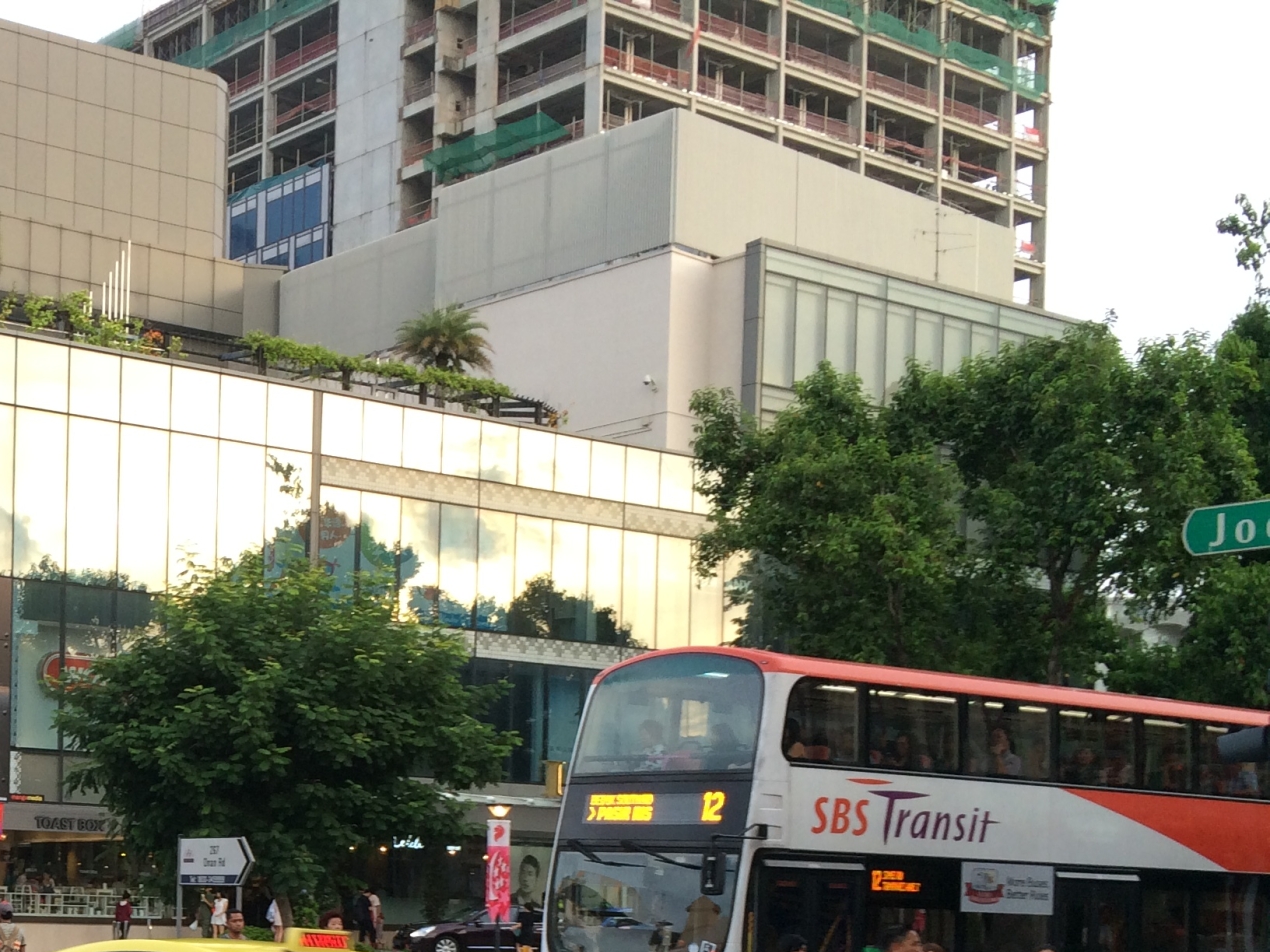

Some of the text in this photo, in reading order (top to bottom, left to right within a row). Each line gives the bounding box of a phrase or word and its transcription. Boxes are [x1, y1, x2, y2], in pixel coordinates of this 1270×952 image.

[1208, 512, 1270, 547] Jo
[701, 791, 726, 821] 12
[811, 791, 1001, 845] SBS Transit
[34, 816, 107, 831] TOAST BOX
